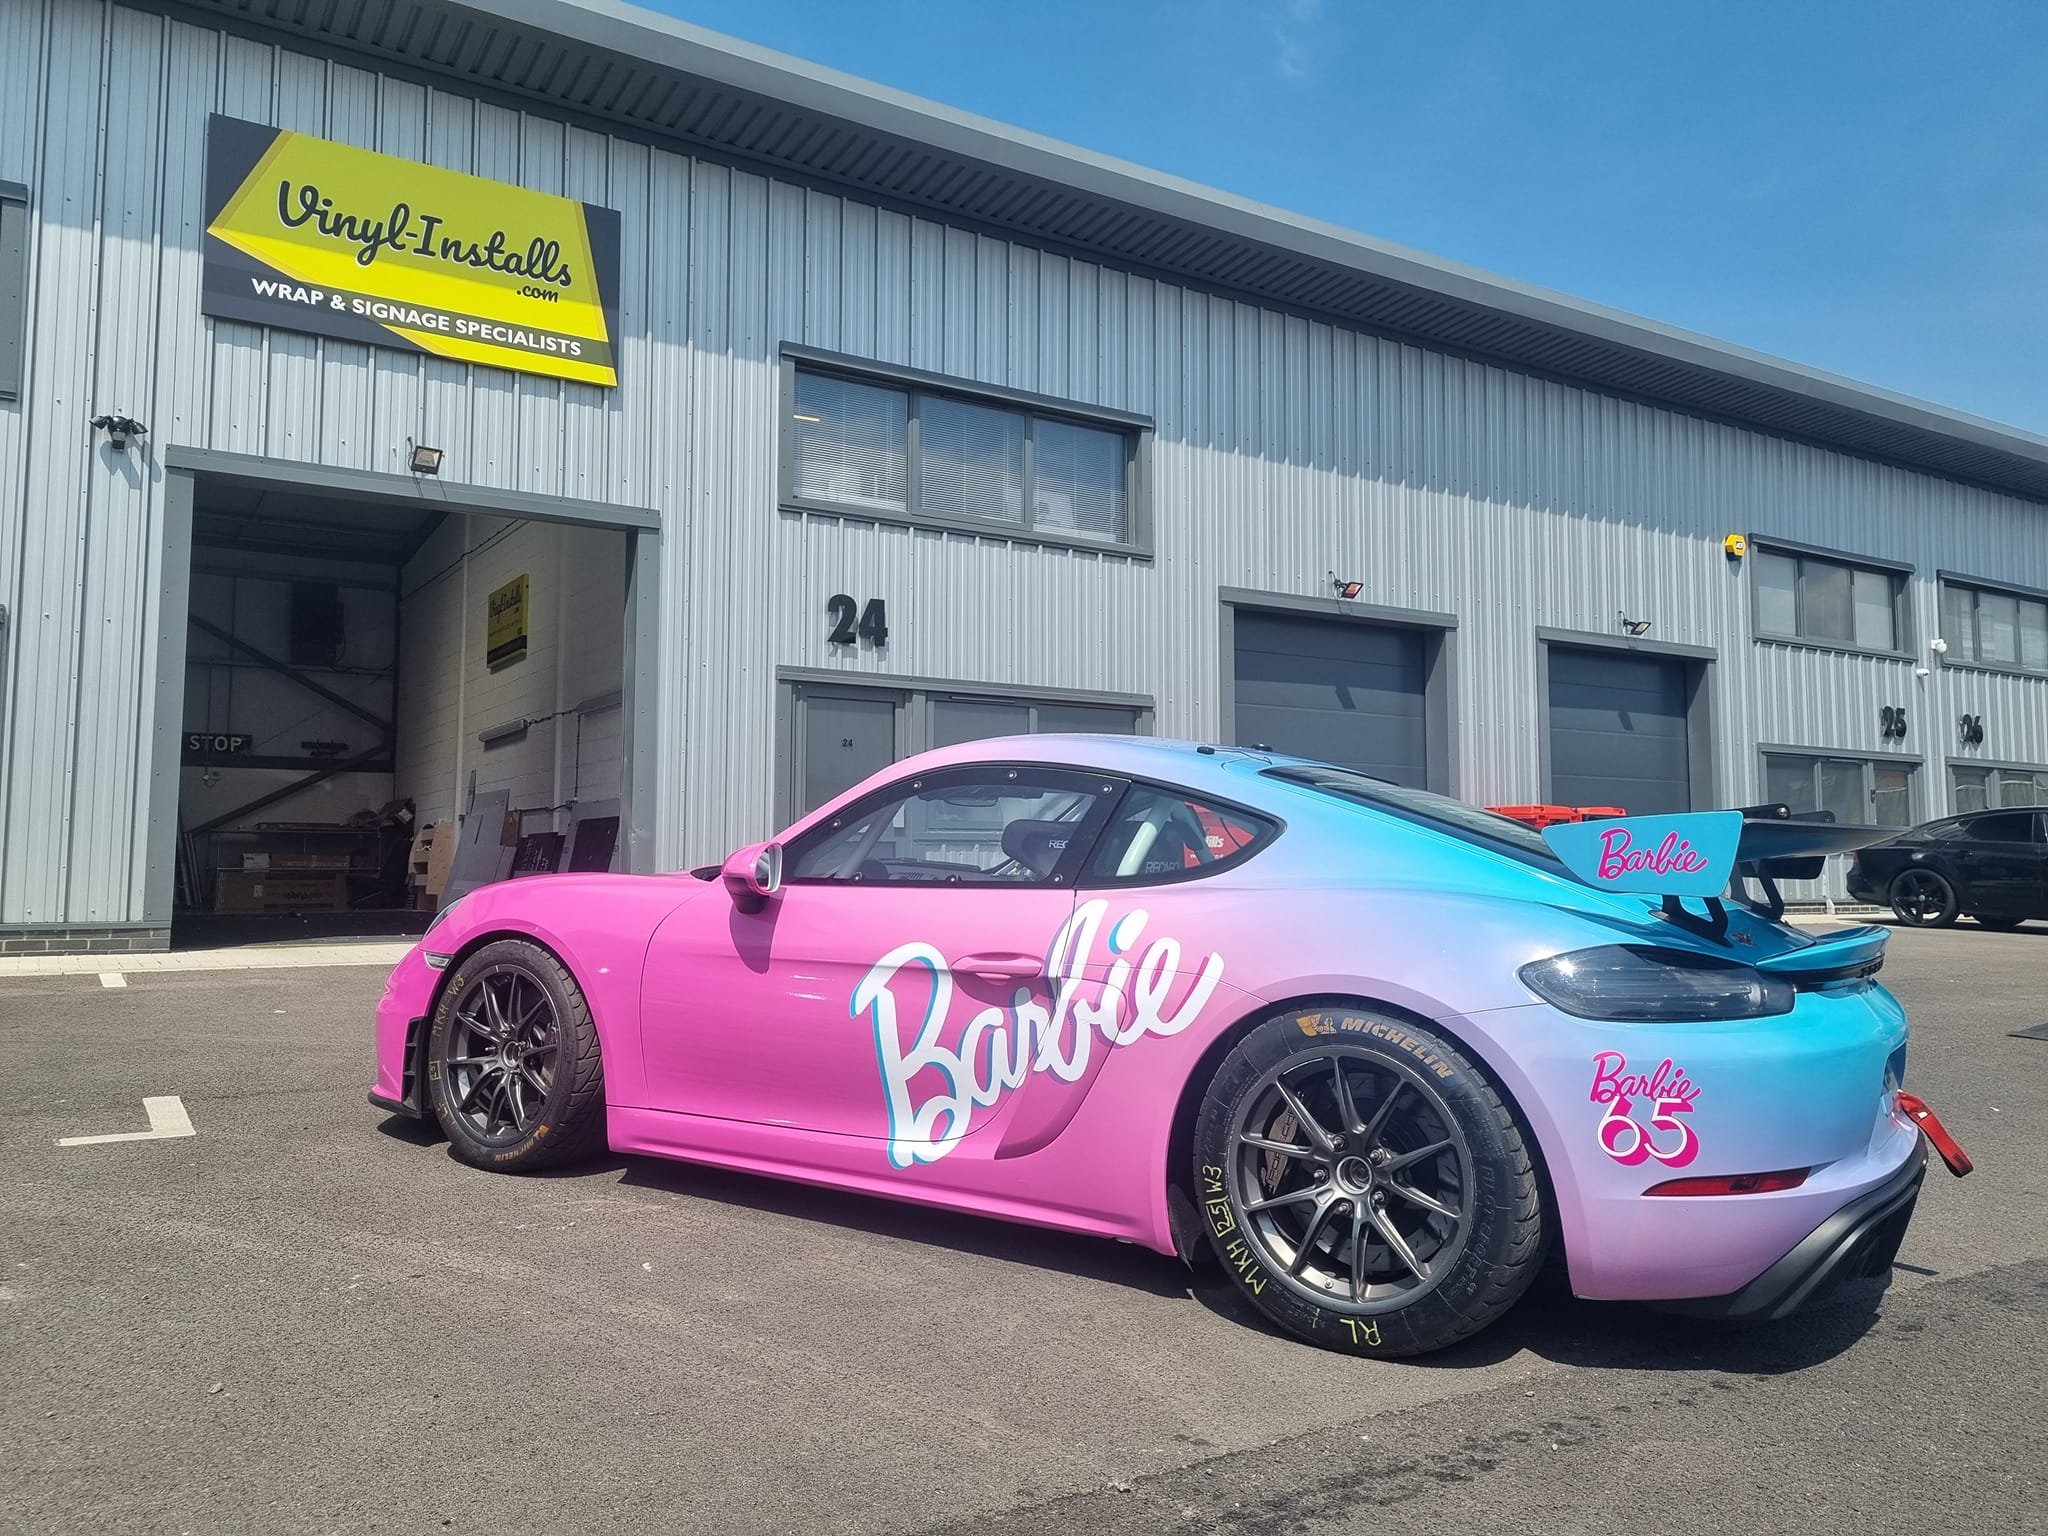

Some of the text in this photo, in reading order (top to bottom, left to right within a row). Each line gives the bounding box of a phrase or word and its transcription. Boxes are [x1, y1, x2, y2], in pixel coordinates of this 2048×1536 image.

[278, 179, 572, 287] Vinyl-Installs
[251, 278, 582, 356] WRAP & SIGNAGE SPECIALISTS
[516, 285, 559, 303] .com
[827, 593, 889, 647] 24
[190, 735, 242, 752] STOP
[842, 738, 853, 747] 24
[1881, 706, 1907, 738] 25
[1961, 714, 1984, 744] 26
[1598, 827, 1708, 880] Barbie
[850, 898, 1224, 1169] Barbie
[1340, 1016, 1455, 1079] MICHELIN
[1590, 1050, 1702, 1105] Barbie
[1597, 1094, 1699, 1168] 65
[1202, 1164, 1224, 1193] W3
[1209, 1203, 1231, 1231] 25
[1226, 1238, 1268, 1295] MKH
[1339, 1318, 1382, 1346] RL
